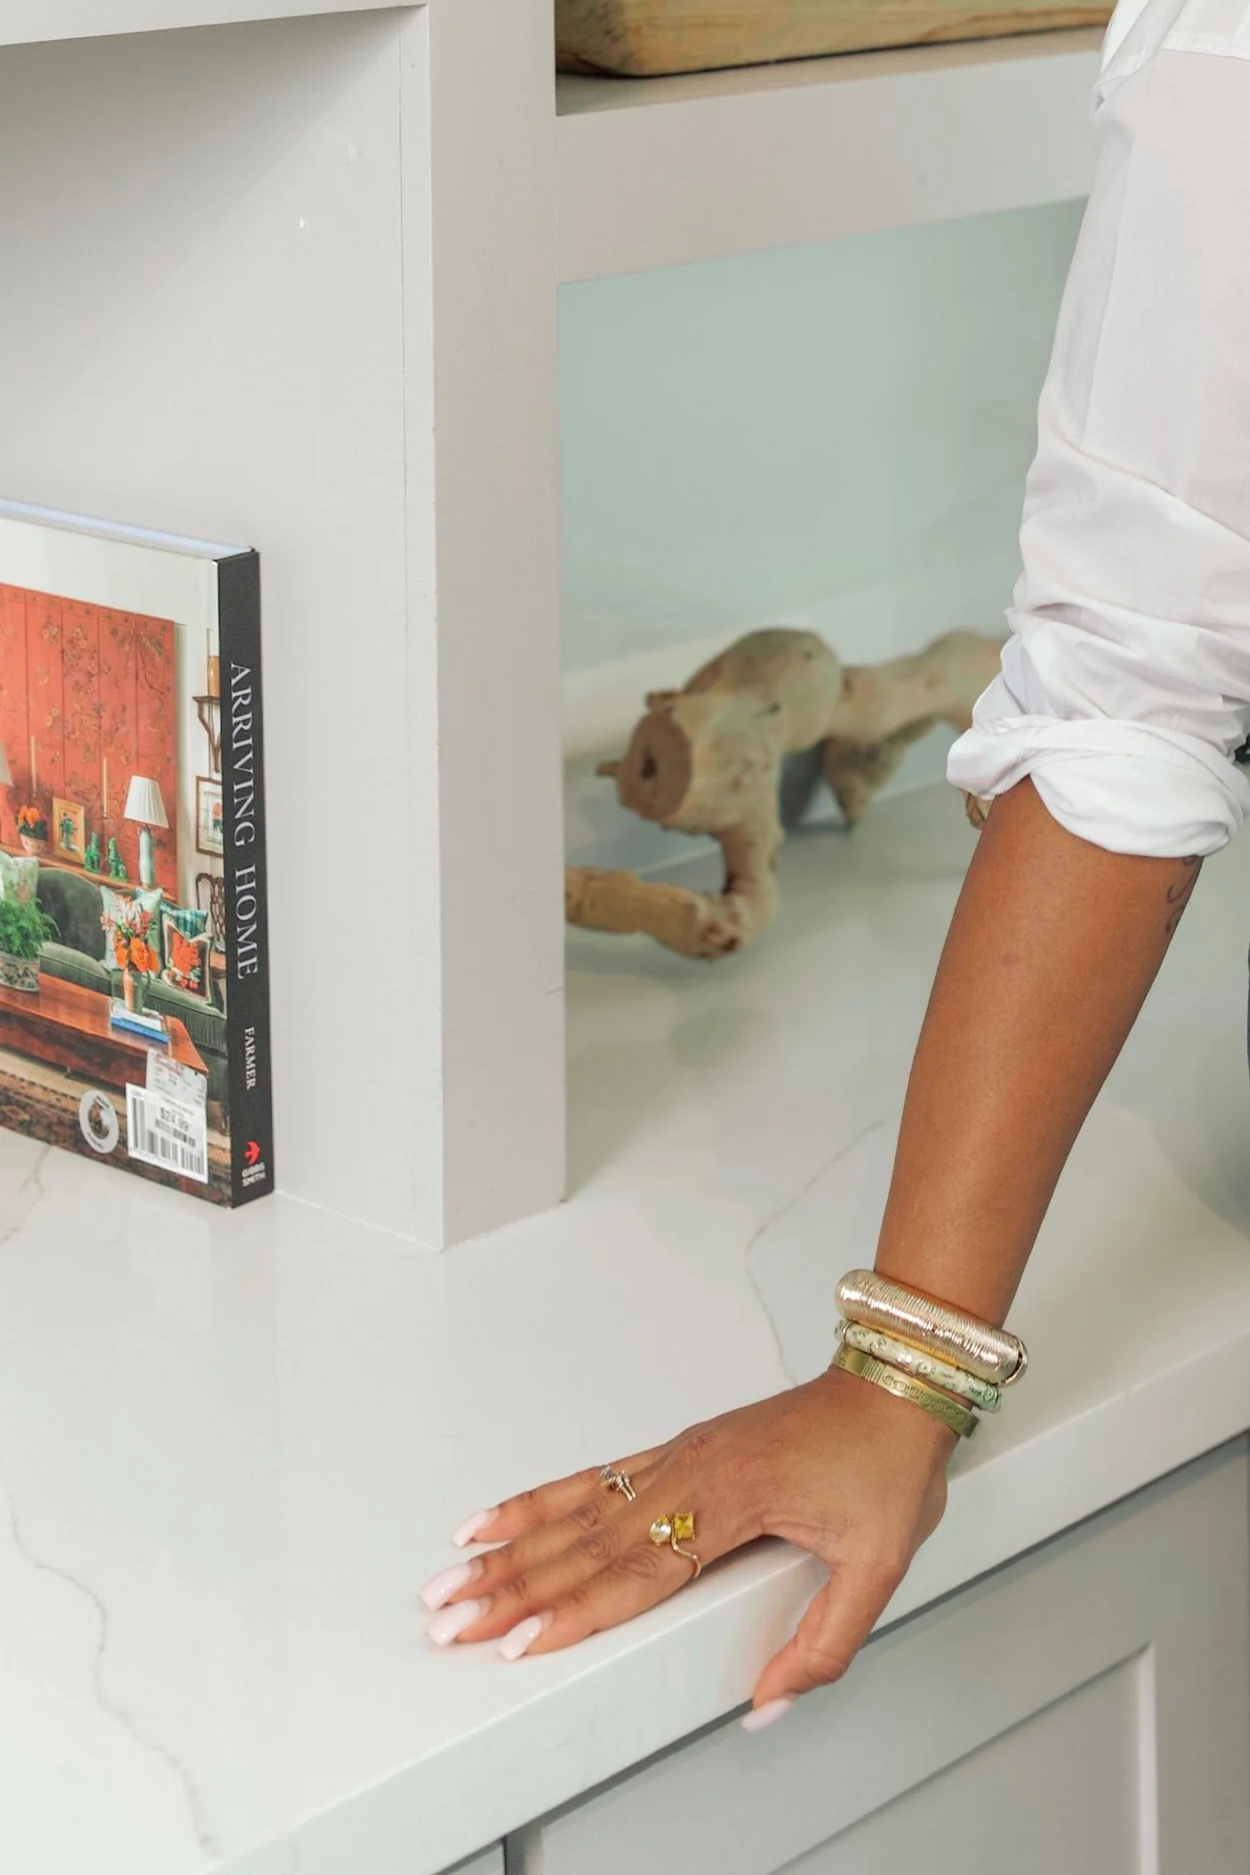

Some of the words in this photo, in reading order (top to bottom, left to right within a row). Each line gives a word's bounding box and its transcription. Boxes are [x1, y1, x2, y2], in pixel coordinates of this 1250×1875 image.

[230, 661, 256, 847] ARRIVING
[235, 863, 259, 980] HOME
[244, 1026, 257, 1091] FARMER
[241, 1162, 266, 1178] GIBBS
[242, 1171, 266, 1187] SMITH
